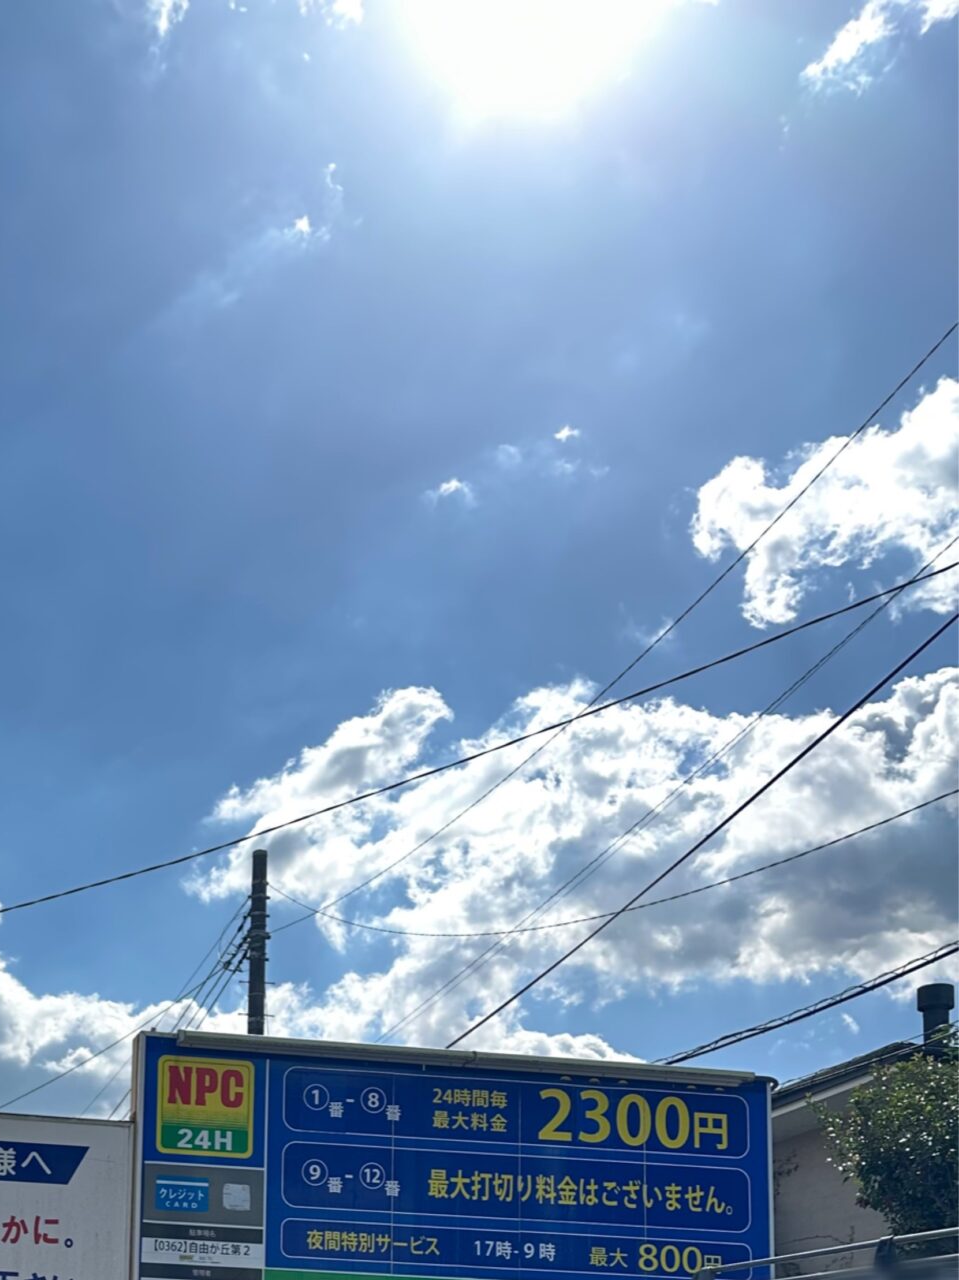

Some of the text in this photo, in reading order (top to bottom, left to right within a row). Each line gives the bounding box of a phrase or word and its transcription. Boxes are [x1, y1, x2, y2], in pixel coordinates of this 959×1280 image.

[167, 1065, 244, 1109] NPC
[432, 1088, 508, 1109] 24時間毎
[432, 1110, 508, 1134] 最大料金
[538, 1087, 729, 1151] 2300円
[177, 1128, 233, 1151] 24H
[159, 1187, 204, 1200] クレジット
[427, 1168, 734, 1217] 最大打切り料金はございません。
[165, 1201, 198, 1209] CARD
[306, 1229, 440, 1257] 夜間特別サービス
[588, 1246, 628, 1269] 最大
